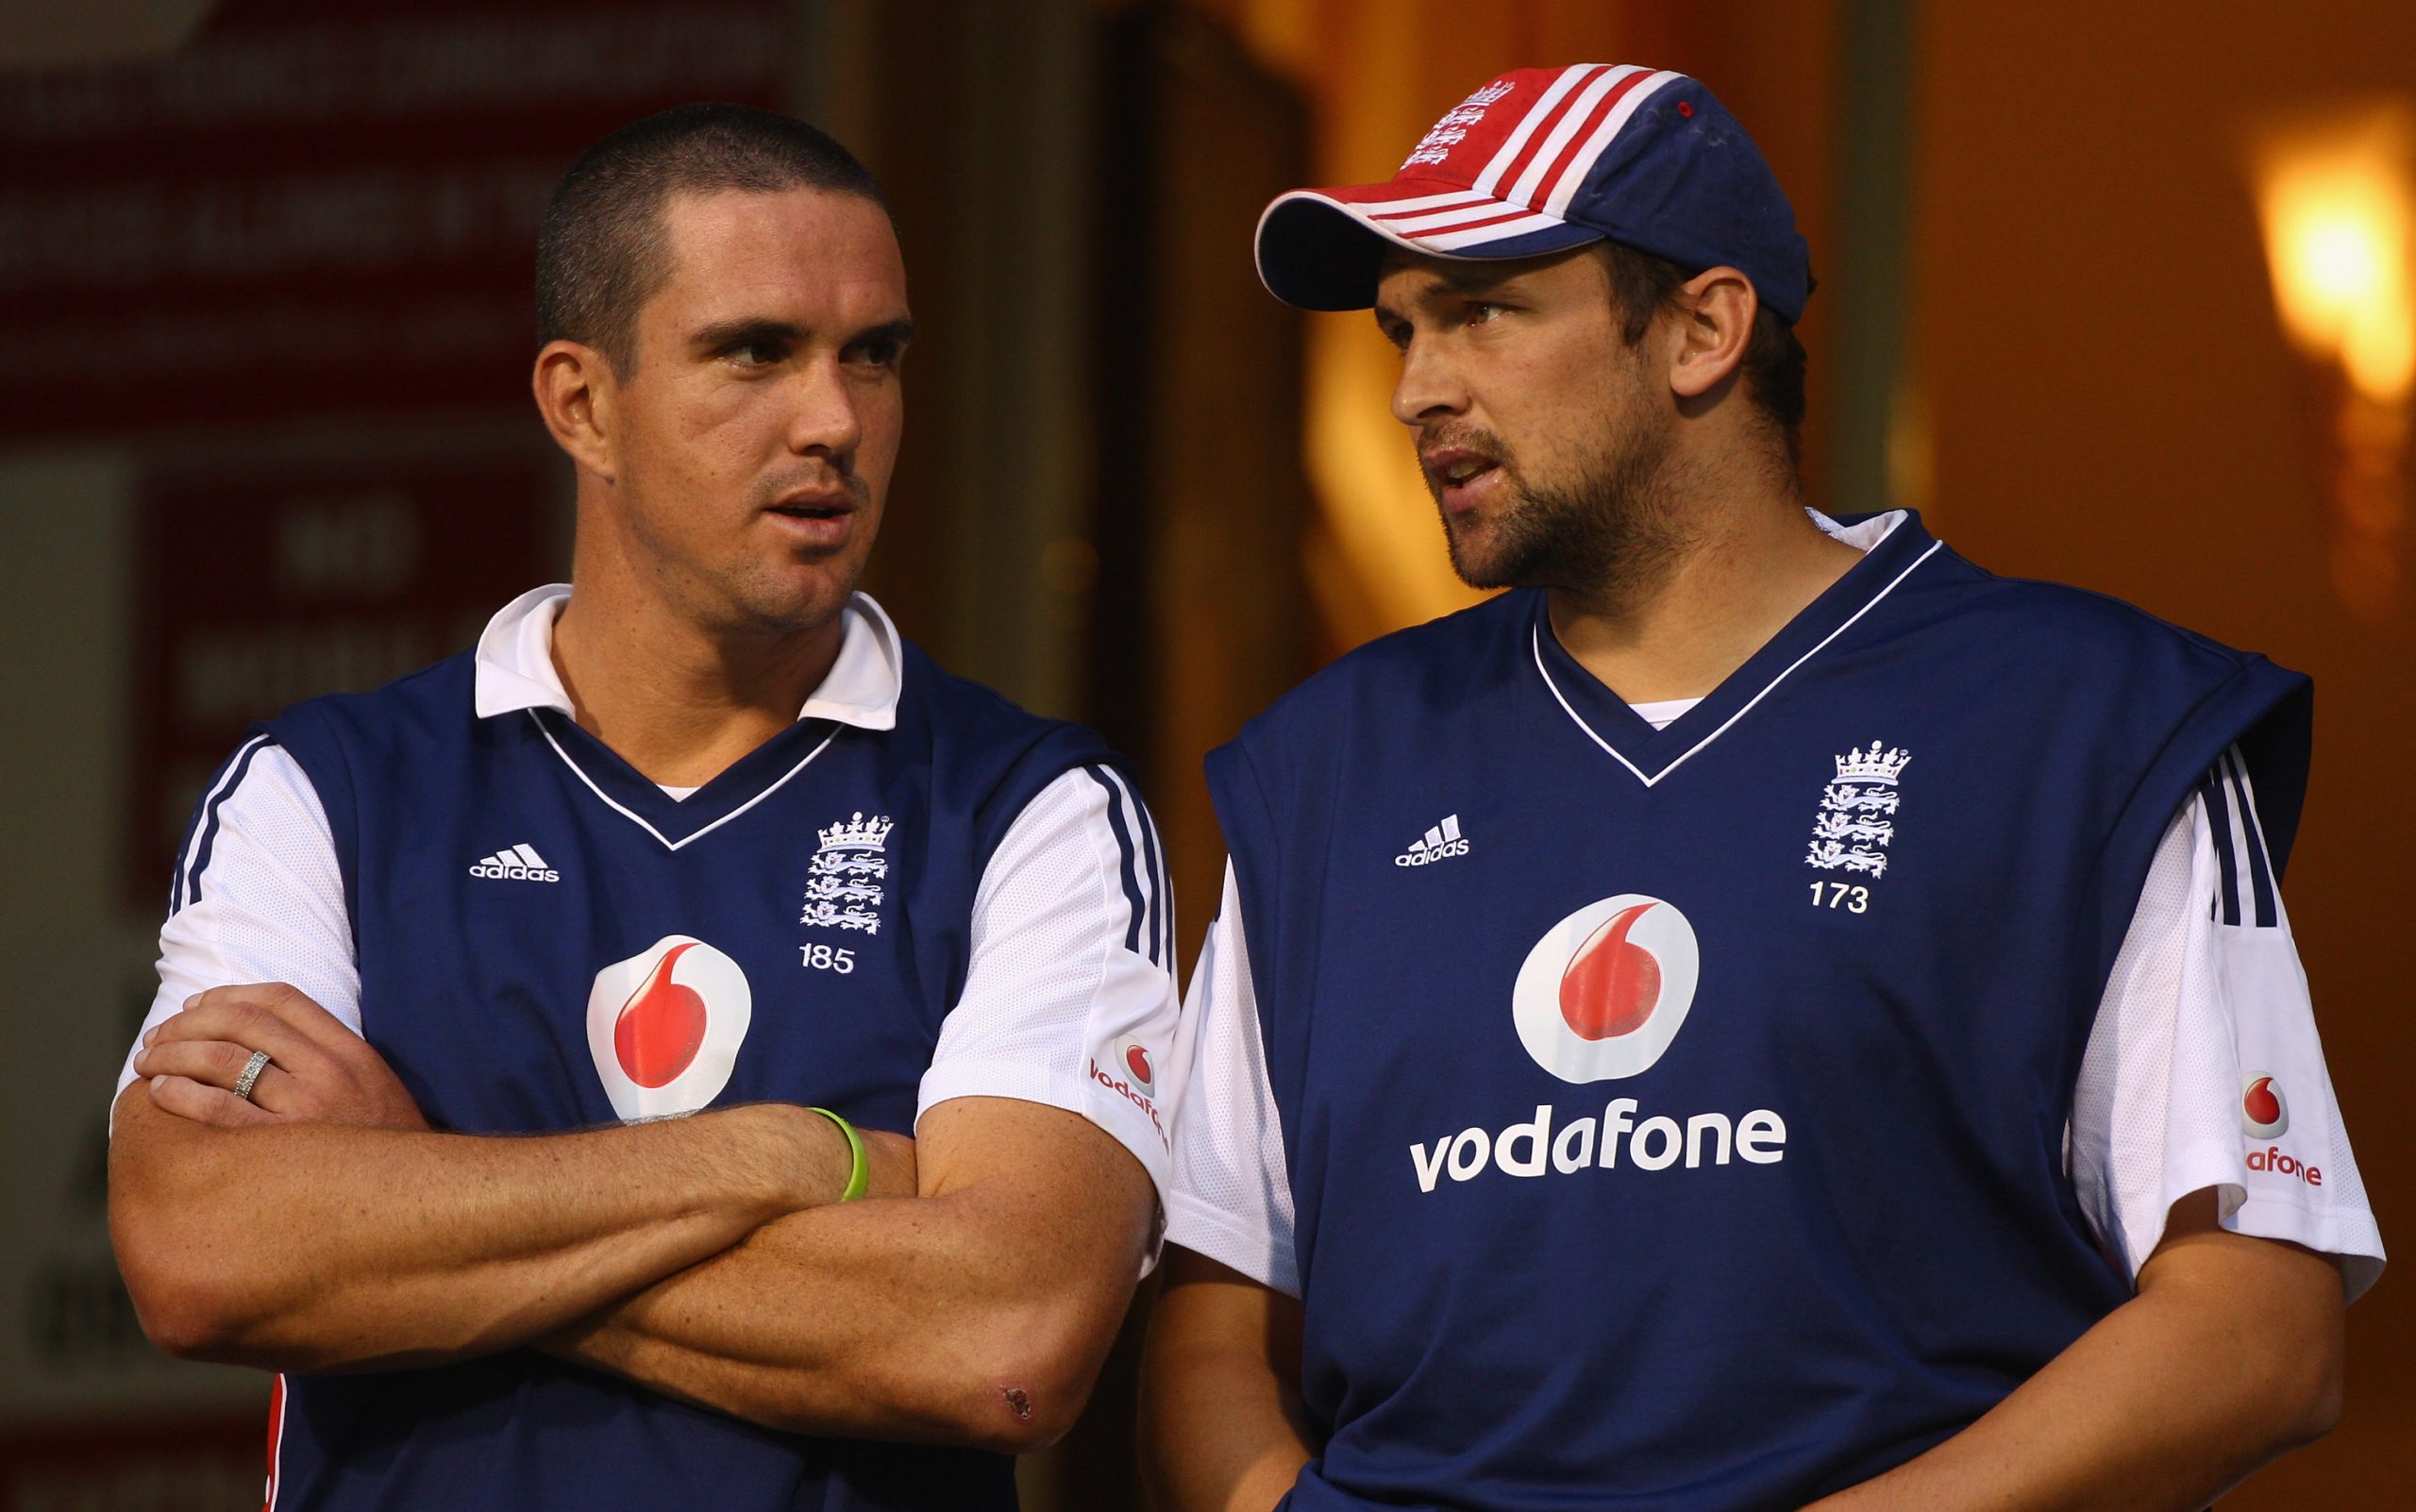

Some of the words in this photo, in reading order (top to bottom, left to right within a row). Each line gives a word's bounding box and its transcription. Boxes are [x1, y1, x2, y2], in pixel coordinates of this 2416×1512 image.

[1395, 835, 1469, 866] adidas
[469, 862, 560, 882] adidas
[1809, 880, 1869, 914] 173
[799, 942, 855, 974] 185
[1409, 1098, 1787, 1193] vodafone
[2246, 1146, 2322, 1186] afone
